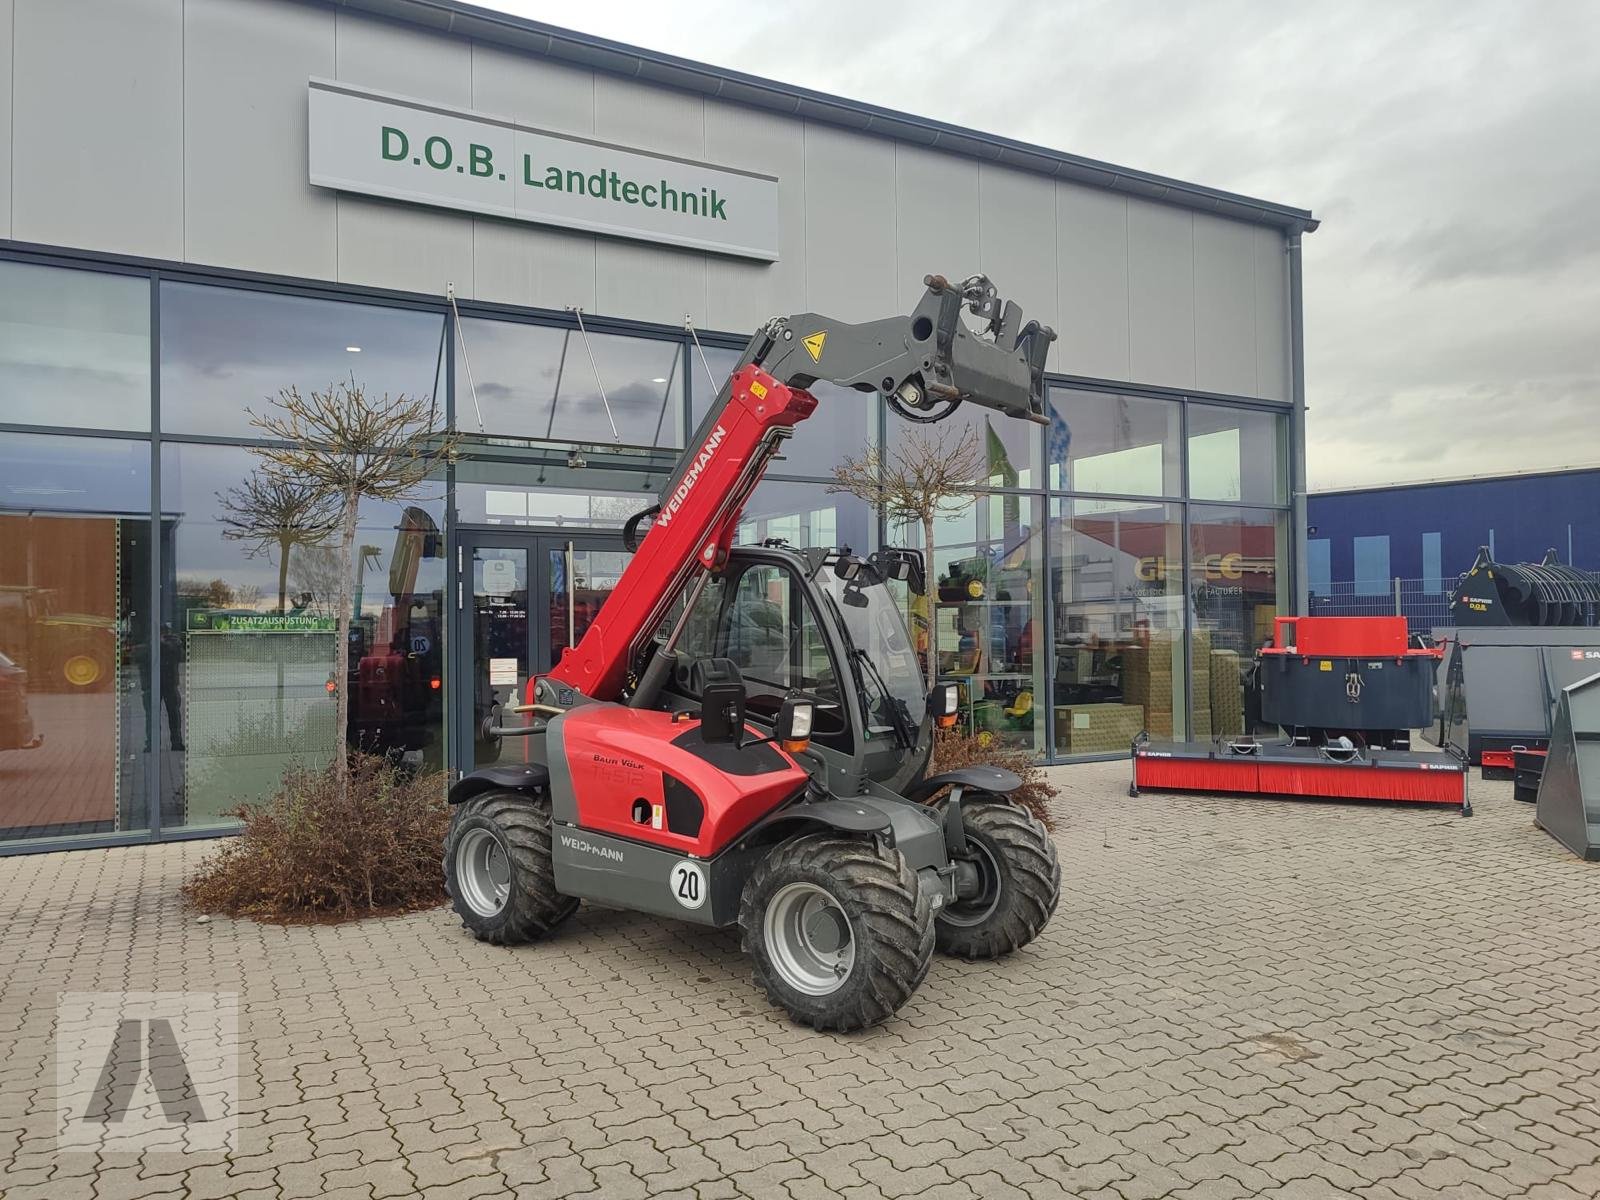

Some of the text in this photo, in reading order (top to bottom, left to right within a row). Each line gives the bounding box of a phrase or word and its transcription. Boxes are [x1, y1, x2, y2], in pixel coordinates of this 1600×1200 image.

[381, 125, 728, 222] D.O.B. Landtechnik
[657, 424, 727, 528] WEIDEMANN
[230, 614, 319, 625] ZUSATZAUSRÜSTUNG
[678, 868, 699, 901] 20
